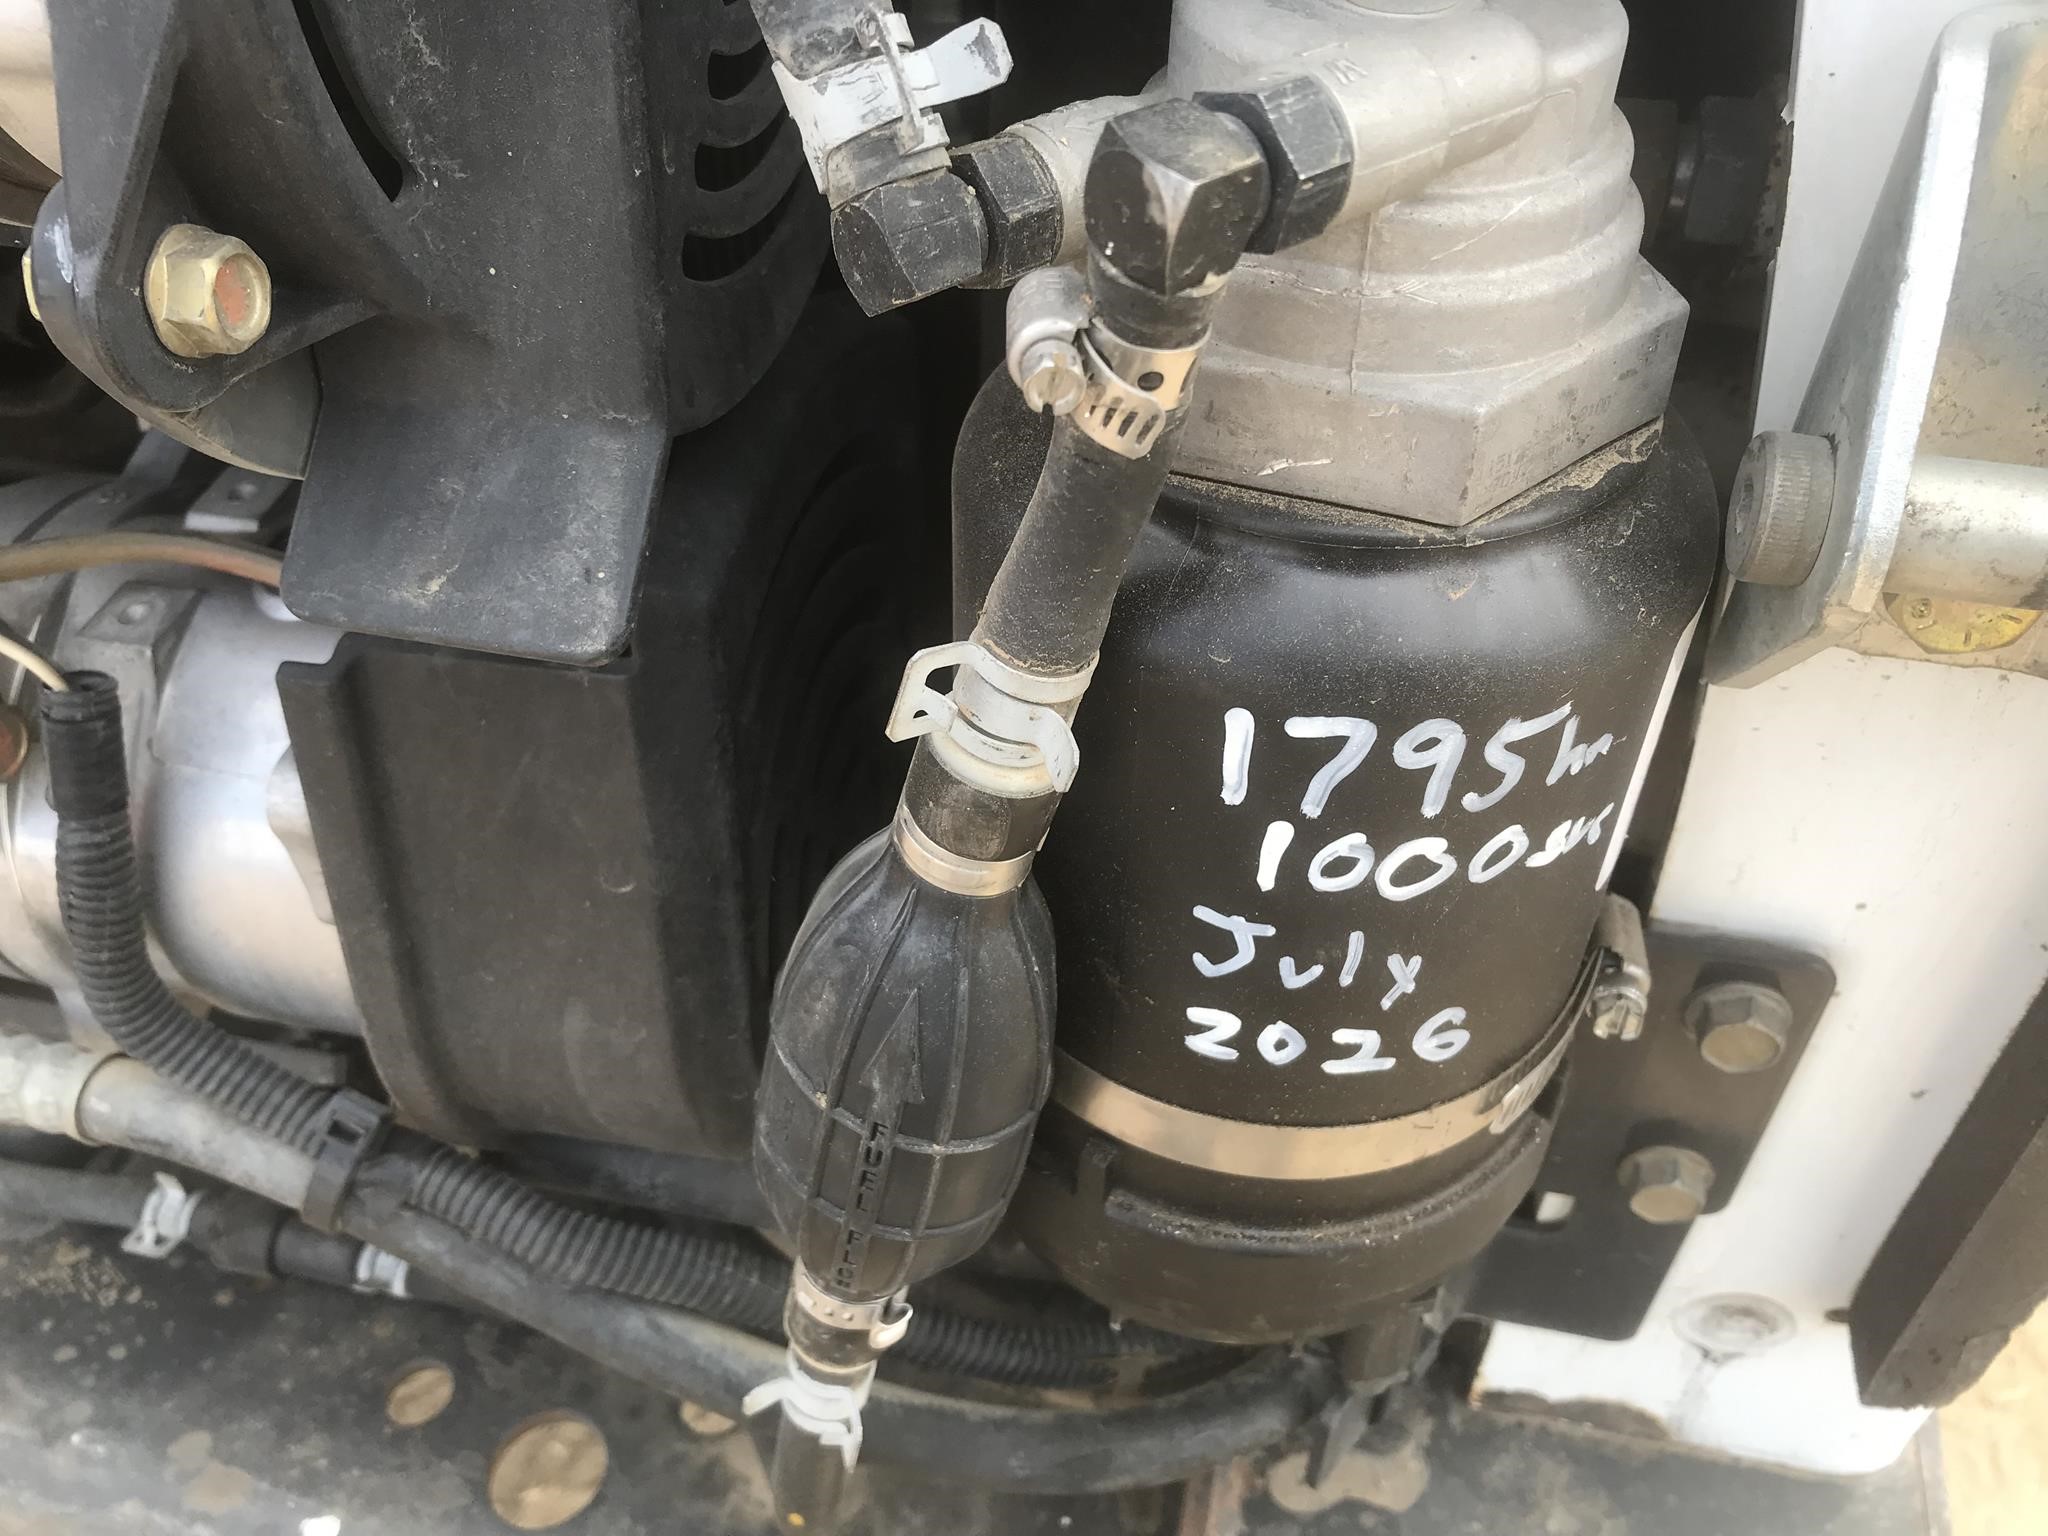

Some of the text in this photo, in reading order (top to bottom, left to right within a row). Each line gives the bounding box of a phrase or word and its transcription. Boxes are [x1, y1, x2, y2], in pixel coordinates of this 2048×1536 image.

[1192, 904, 1422, 1011] July
[1184, 1006, 1471, 1075] 2026
[856, 1121, 889, 1213] FUEL
